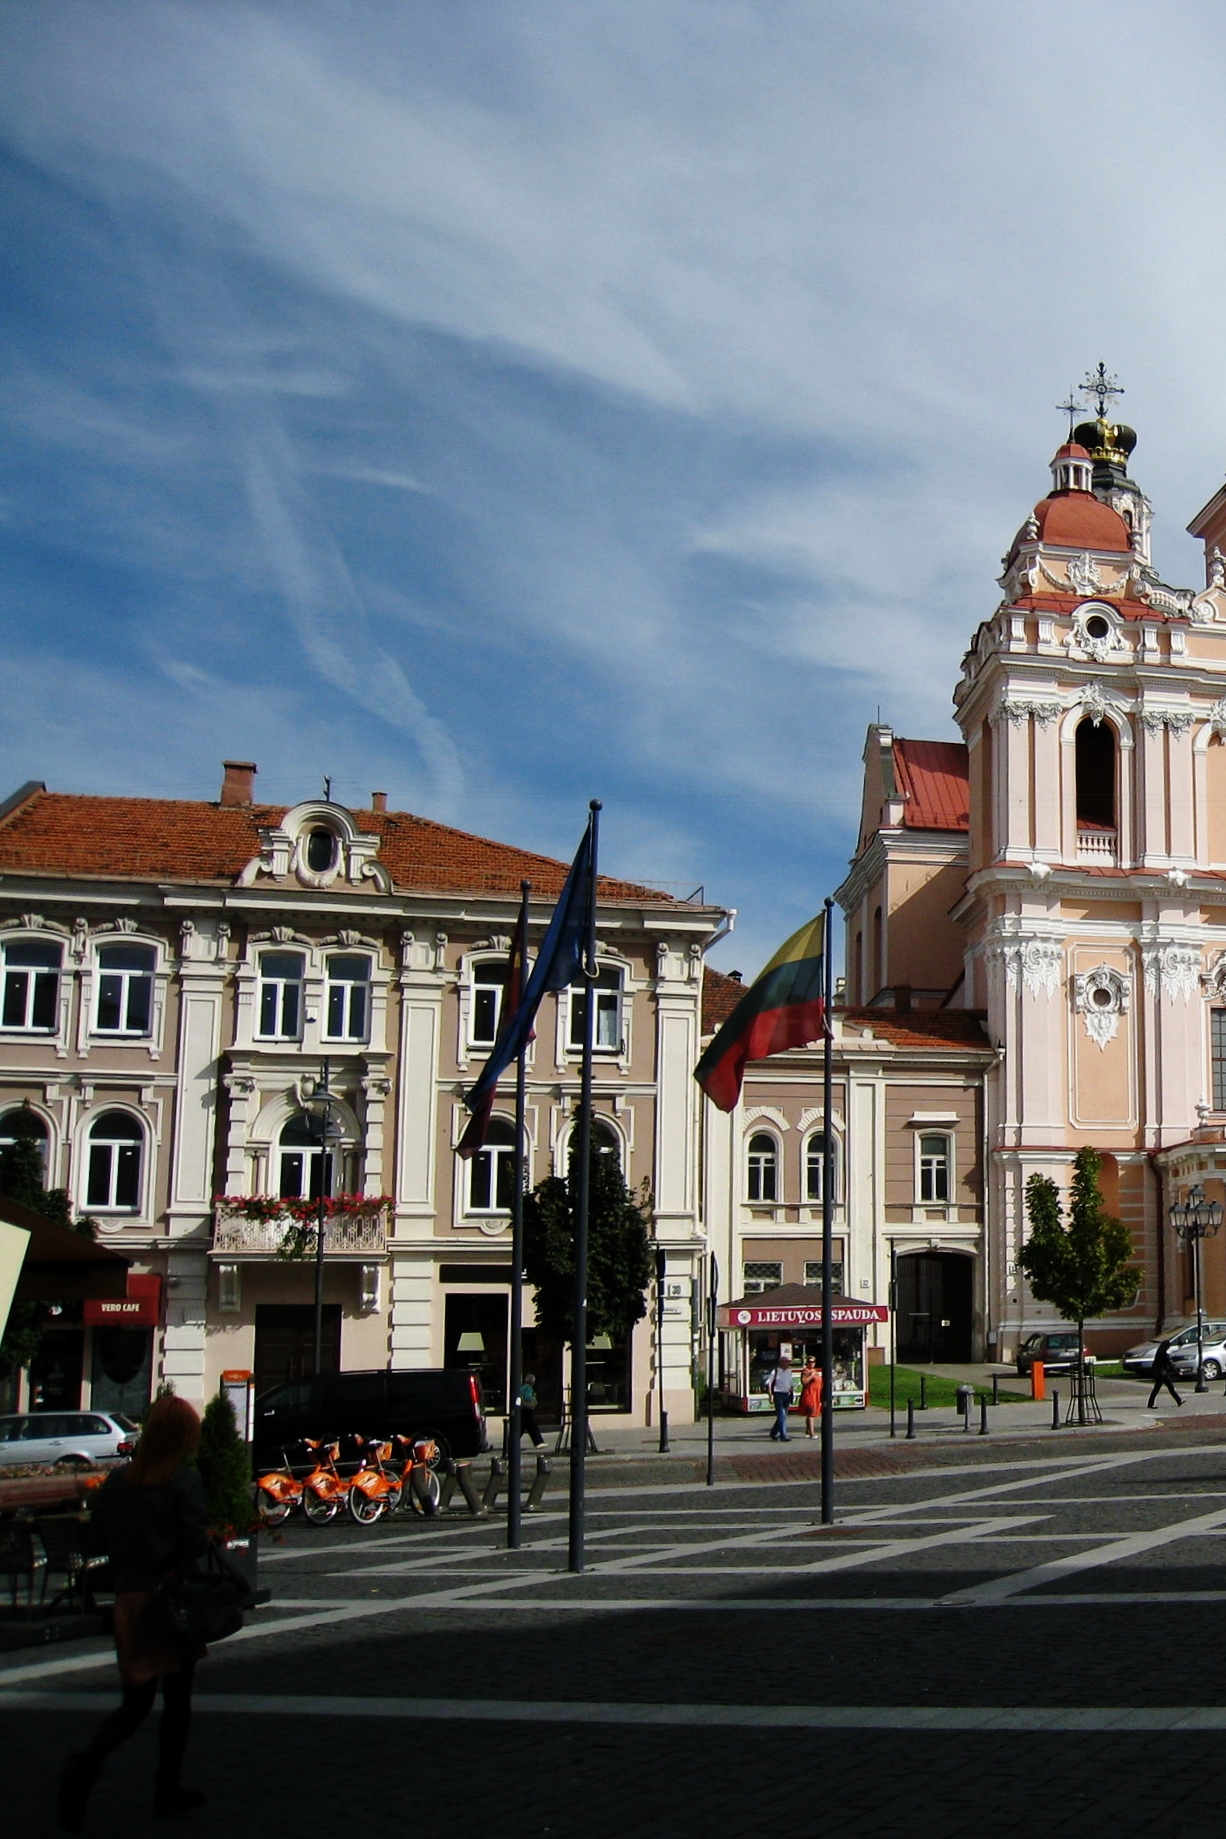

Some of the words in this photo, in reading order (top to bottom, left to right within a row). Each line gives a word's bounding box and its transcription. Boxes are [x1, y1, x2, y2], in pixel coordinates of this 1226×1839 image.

[101, 1303, 122, 1312] VERO
[757, 1310, 822, 1324] LIETUVOS
[831, 1309, 880, 1321] SPAUDA
